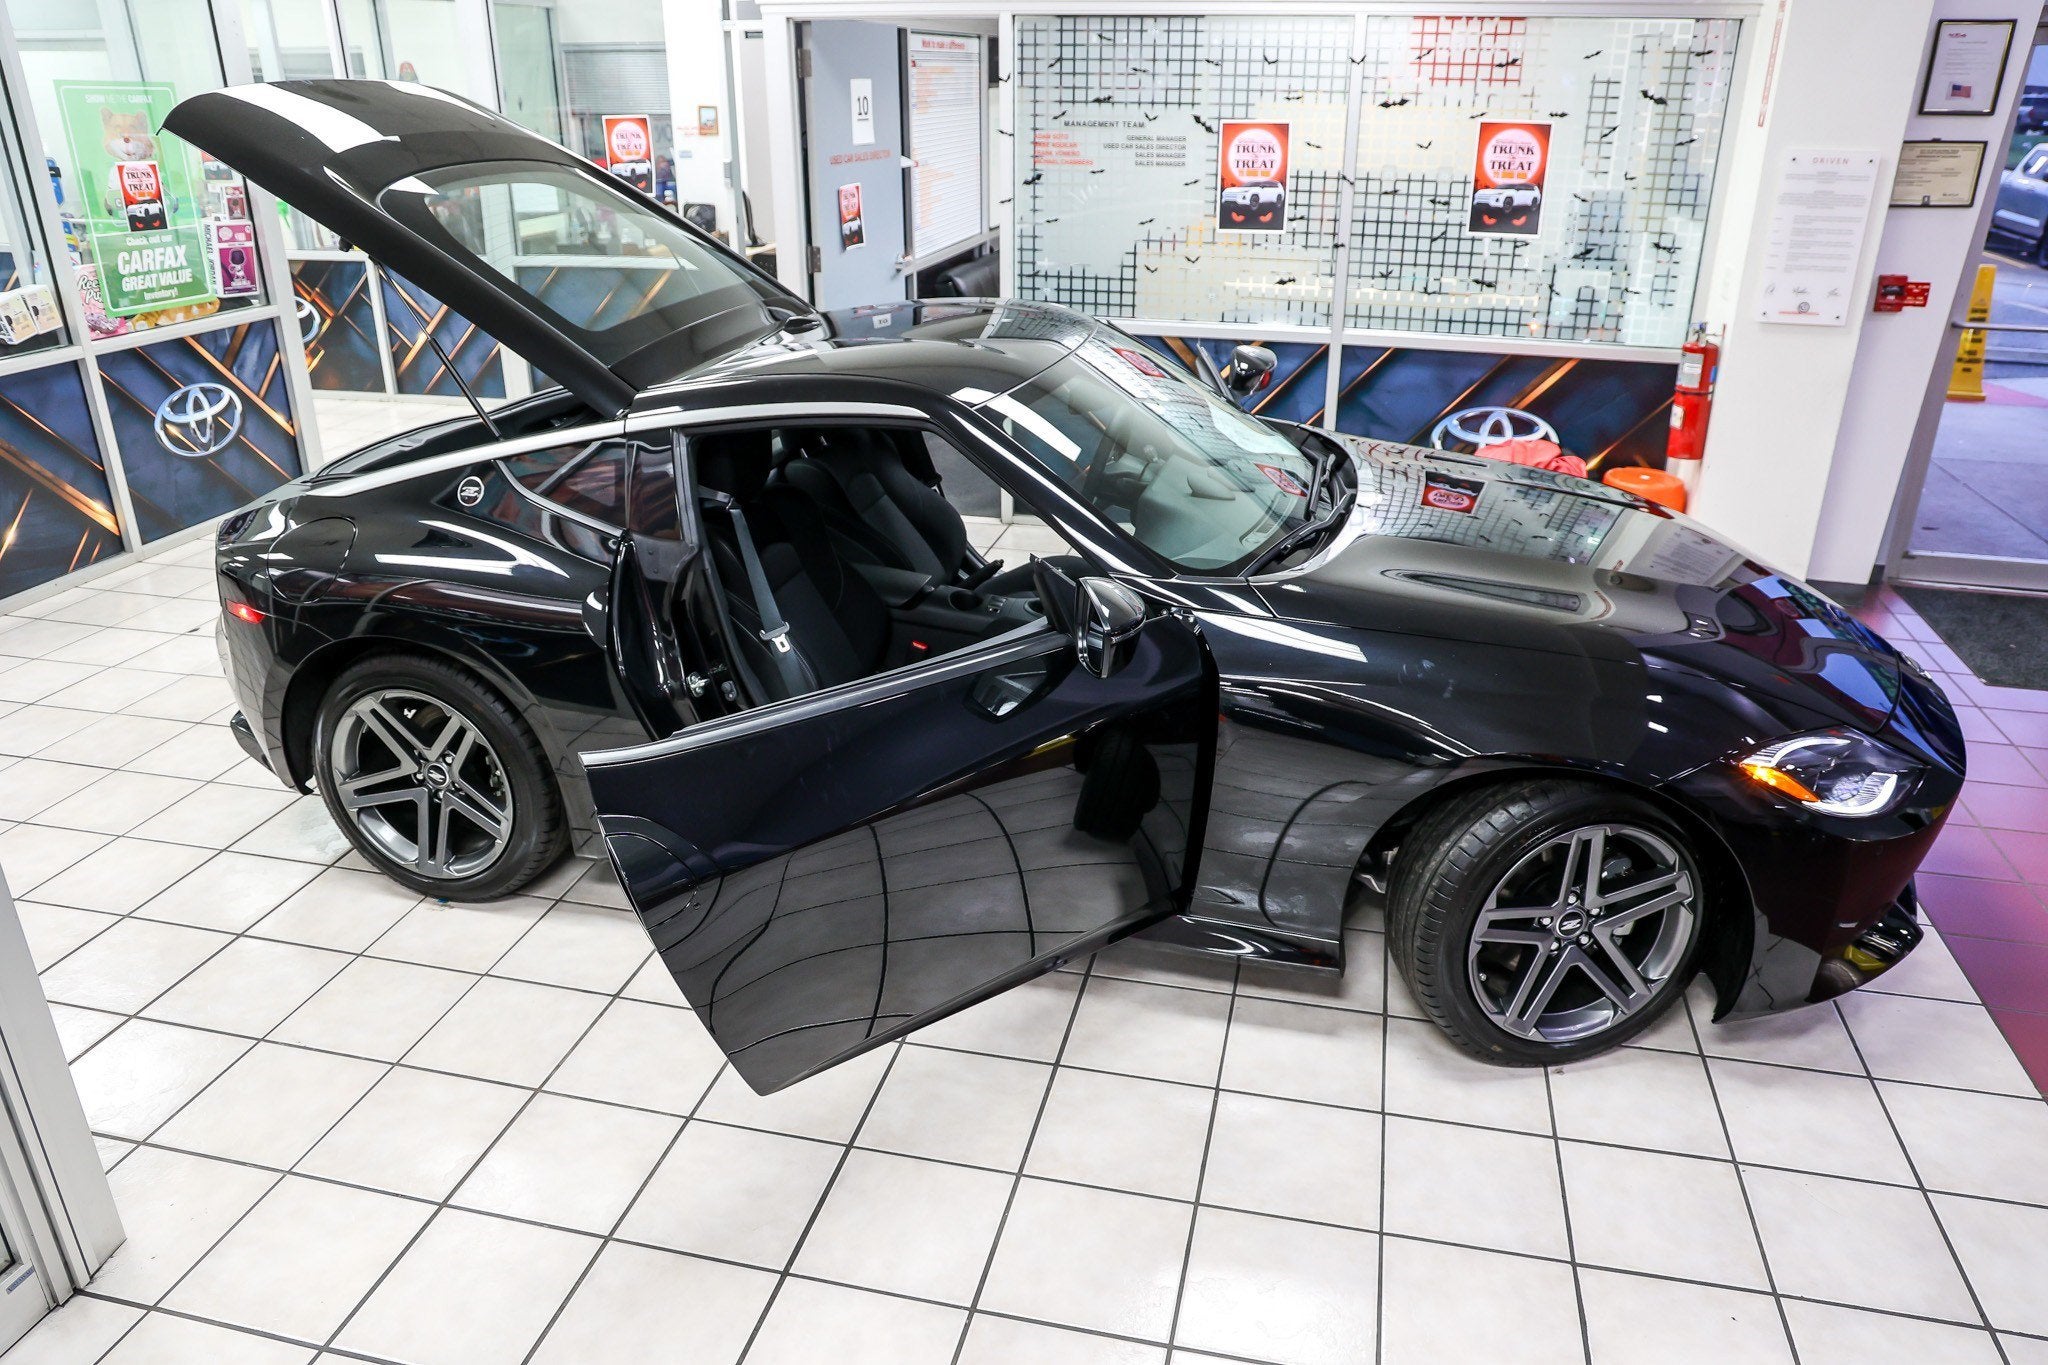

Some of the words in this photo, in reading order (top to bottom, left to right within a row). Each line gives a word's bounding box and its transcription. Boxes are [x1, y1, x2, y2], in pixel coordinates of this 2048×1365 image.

[857, 96, 869, 116] 10
[1063, 120, 1119, 128] MANAGEMENT
[1235, 144, 1276, 153] TRUNK
[1492, 144, 1536, 155] TRUNK
[1235, 159, 1276, 169] TREAT
[1490, 160, 1534, 170] TREAT
[1812, 157, 1849, 165] DRIVEN
[126, 171, 152, 180] TRUNK
[128, 183, 154, 191] TREAT
[204, 224, 213, 255] MICHAEL
[117, 245, 188, 275] CARFAX
[207, 256, 217, 286] JORDAN
[121, 274, 158, 292] GREAT
[158, 268, 193, 286] VALUE
